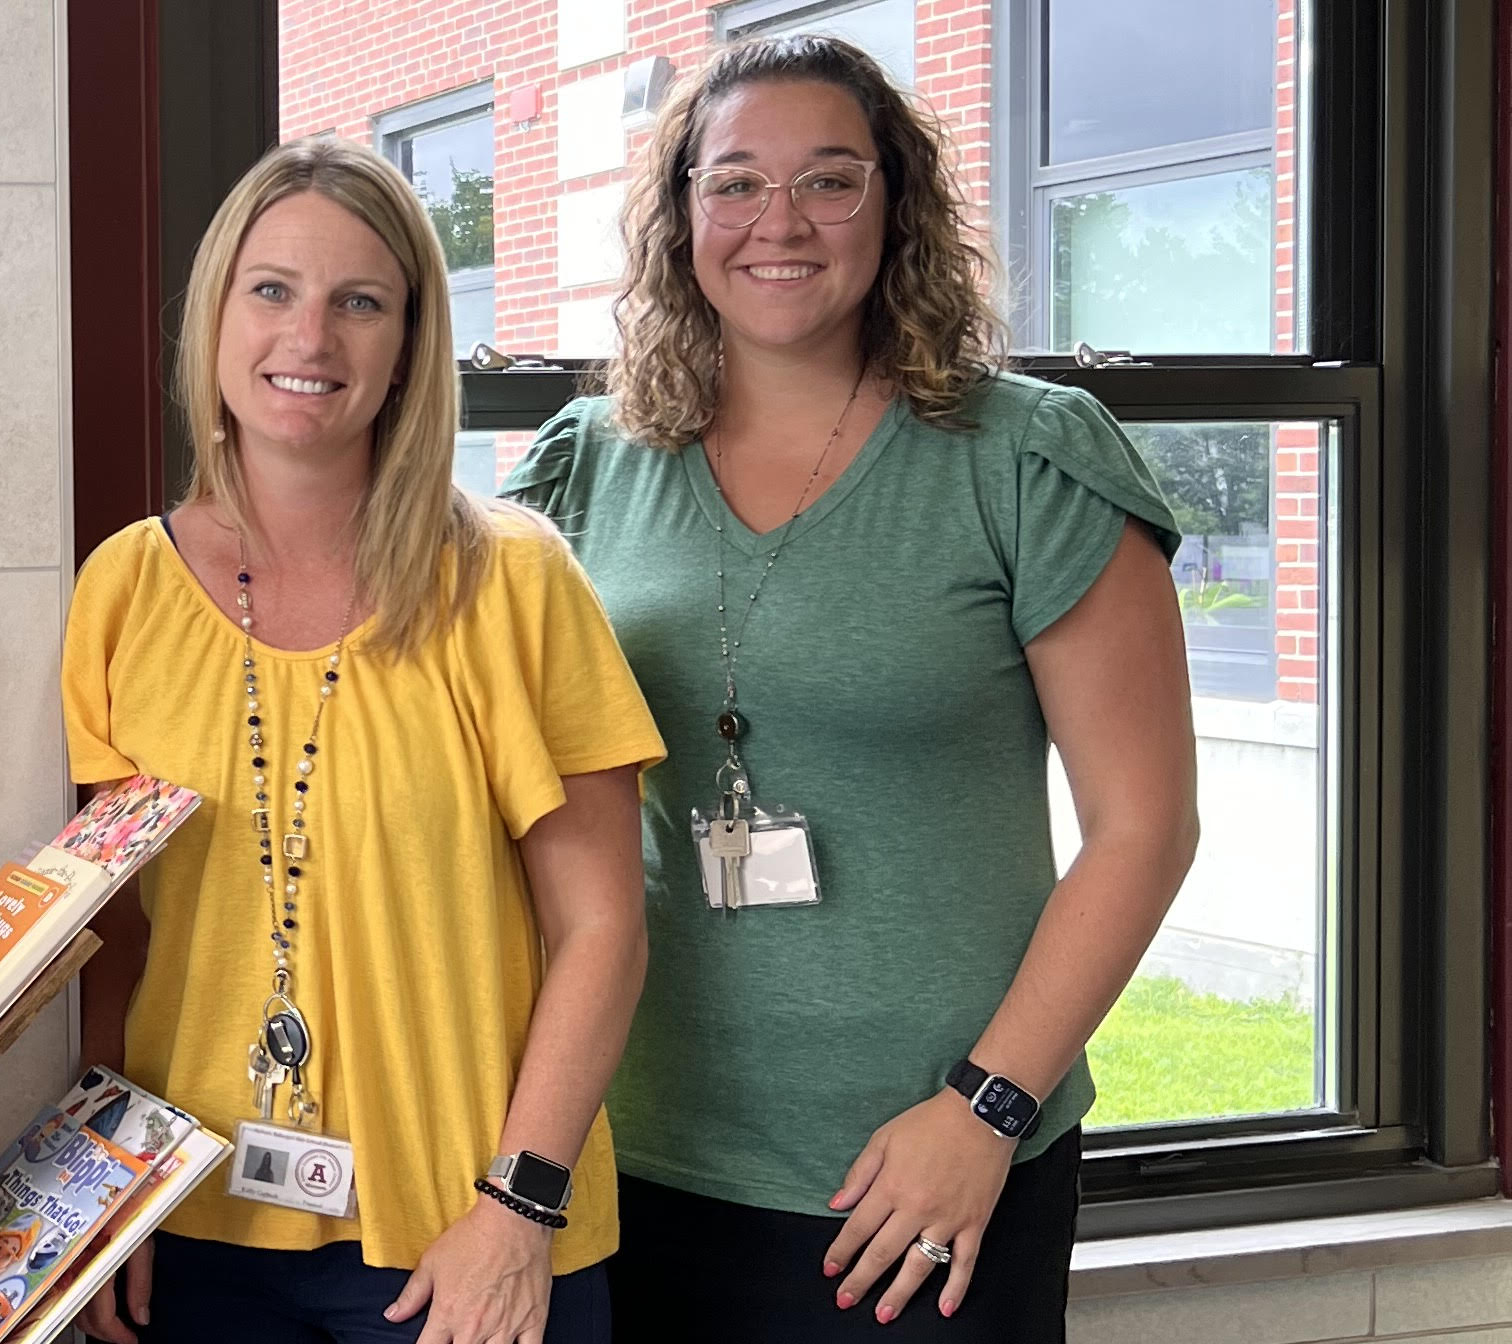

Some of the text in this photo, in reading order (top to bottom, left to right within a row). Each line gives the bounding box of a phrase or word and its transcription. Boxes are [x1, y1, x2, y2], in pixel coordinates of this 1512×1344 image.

[55, 1133, 120, 1197] Blippi
[307, 1162, 329, 1183] A
[2, 1170, 85, 1236] Things That Go!
